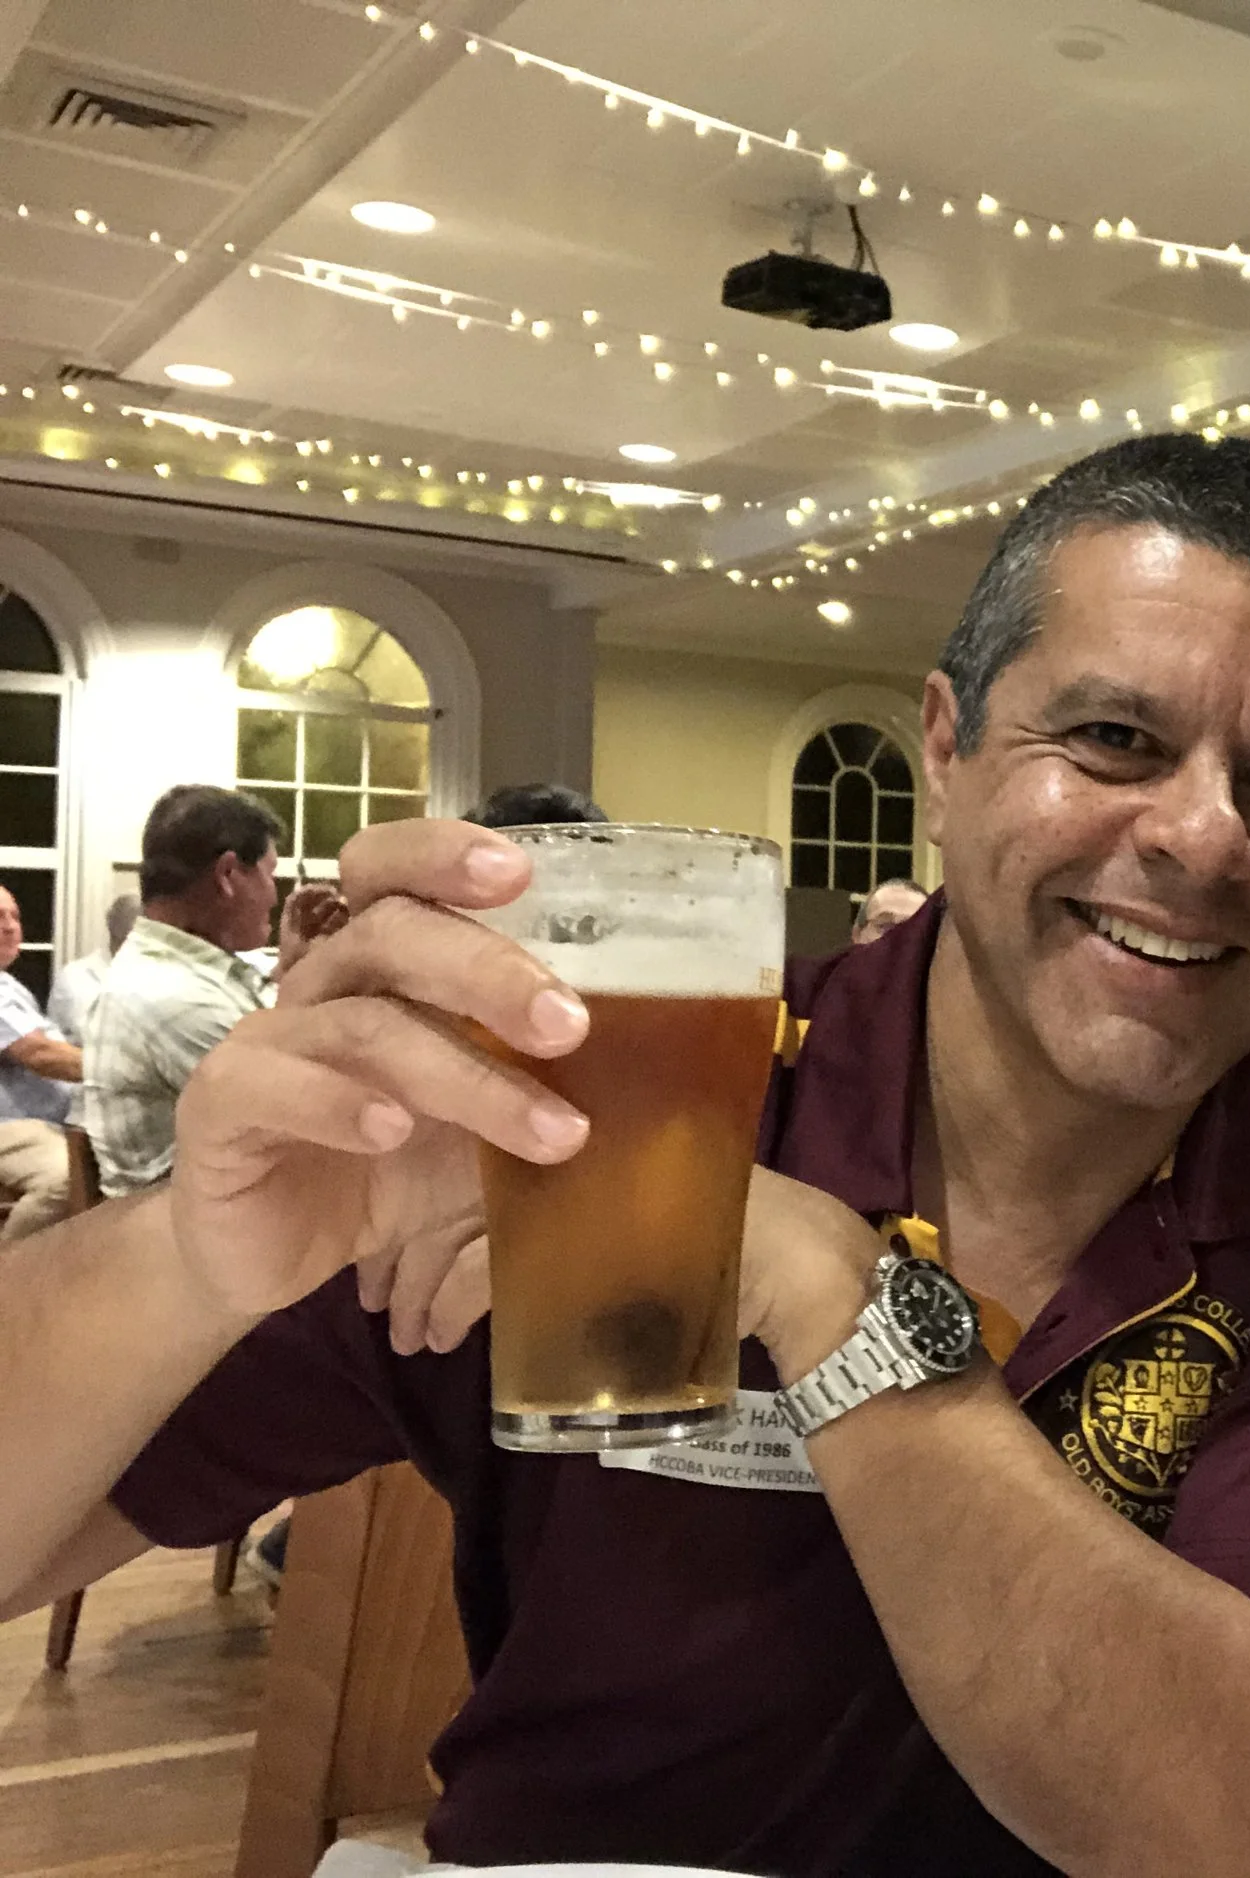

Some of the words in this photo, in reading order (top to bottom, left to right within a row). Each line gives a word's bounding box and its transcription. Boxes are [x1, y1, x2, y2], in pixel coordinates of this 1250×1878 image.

[730, 1440, 750, 1455] of
[753, 1442, 792, 1458] 1986
[1061, 1432, 1092, 1477] OLD
[648, 1454, 704, 1476] HCCOBA
